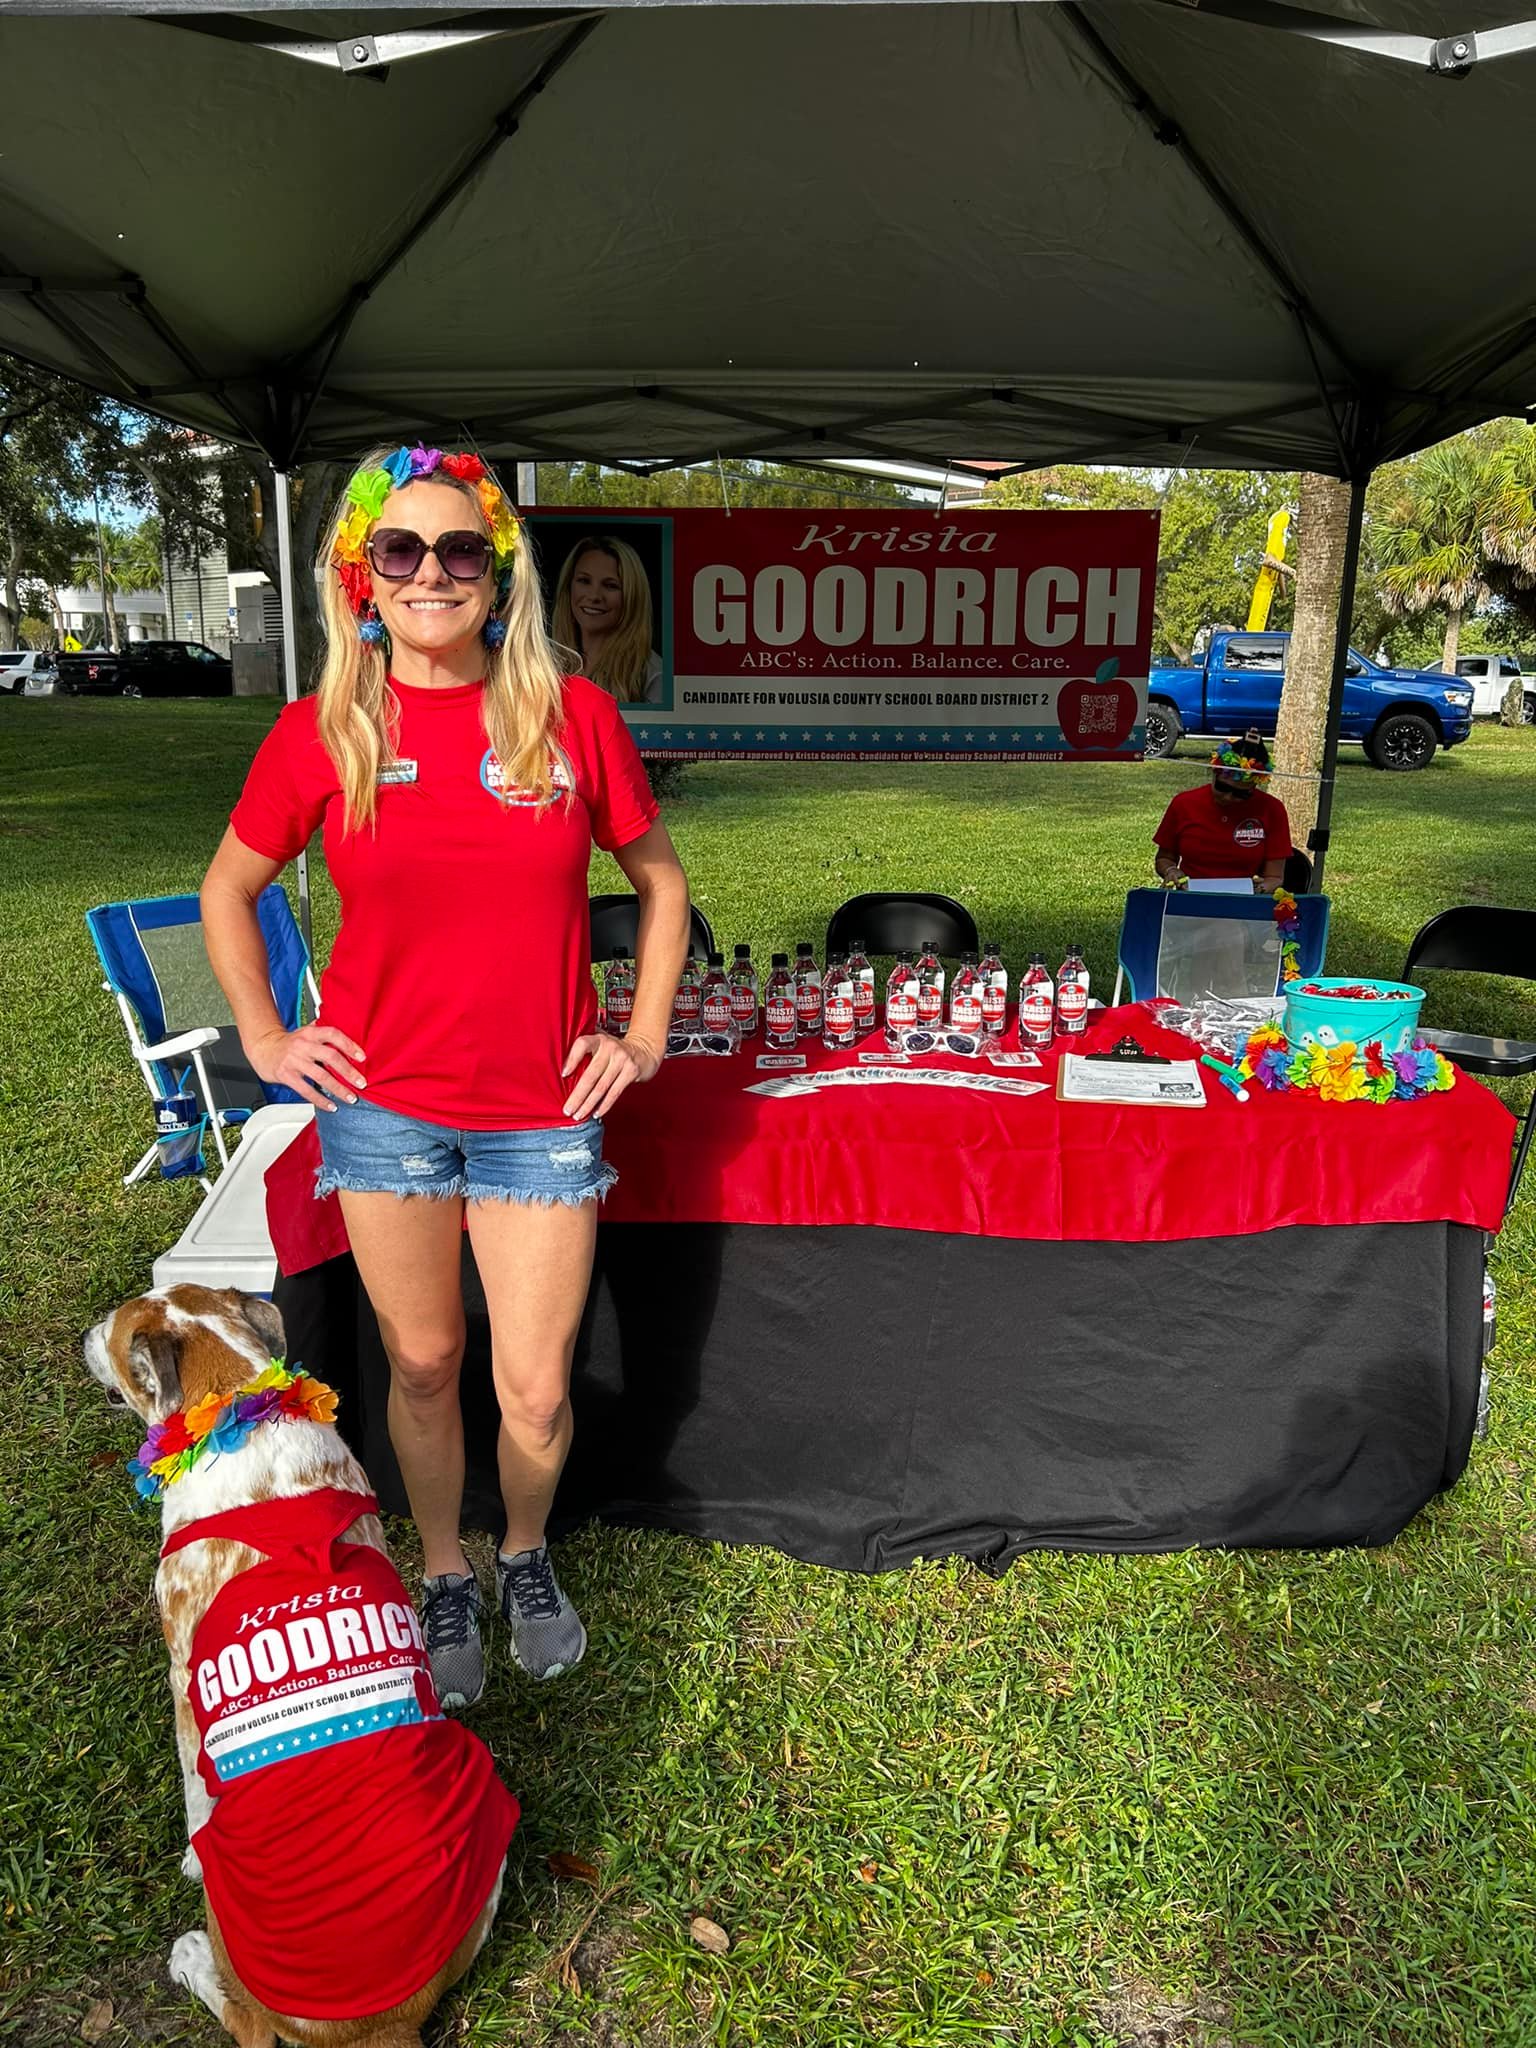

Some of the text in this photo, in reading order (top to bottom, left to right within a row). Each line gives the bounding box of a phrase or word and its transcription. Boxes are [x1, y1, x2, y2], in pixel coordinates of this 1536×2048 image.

[793, 524, 997, 556] Krista
[692, 564, 1141, 648] GOODRICH
[740, 651, 1071, 669] ABC's: Action. Balance. Care.
[683, 691, 1049, 706] CANDIDATE FOR VOLUSIA COUNTY SCHOOL BOARD DISTRICT 2
[746, 752, 783, 761] approved
[784, 752, 794, 761] by
[795, 752, 819, 760] Krista
[859, 752, 899, 761] Candidate
[901, 752, 912, 760] for
[944, 752, 972, 762] County
[974, 752, 1001, 761] School
[1027, 752, 1057, 761] District
[1058, 752, 1064, 761] 2
[608, 996, 633, 1005] KRIST
[766, 1006, 794, 1015] KRISTA
[825, 1007, 853, 1015] KRISTA
[235, 1585, 364, 1634] Krista
[197, 1602, 425, 1713] GOODRICH
[220, 1654, 415, 1718] ABC's: Action. Balance. Care.
[234, 1724, 247, 1735] FOR
[247, 1711, 280, 1730] VOLUSIA
[281, 1700, 314, 1718] COUNTY
[316, 1692, 348, 1708] SCHOOL
[350, 1684, 377, 1698] BOARD
